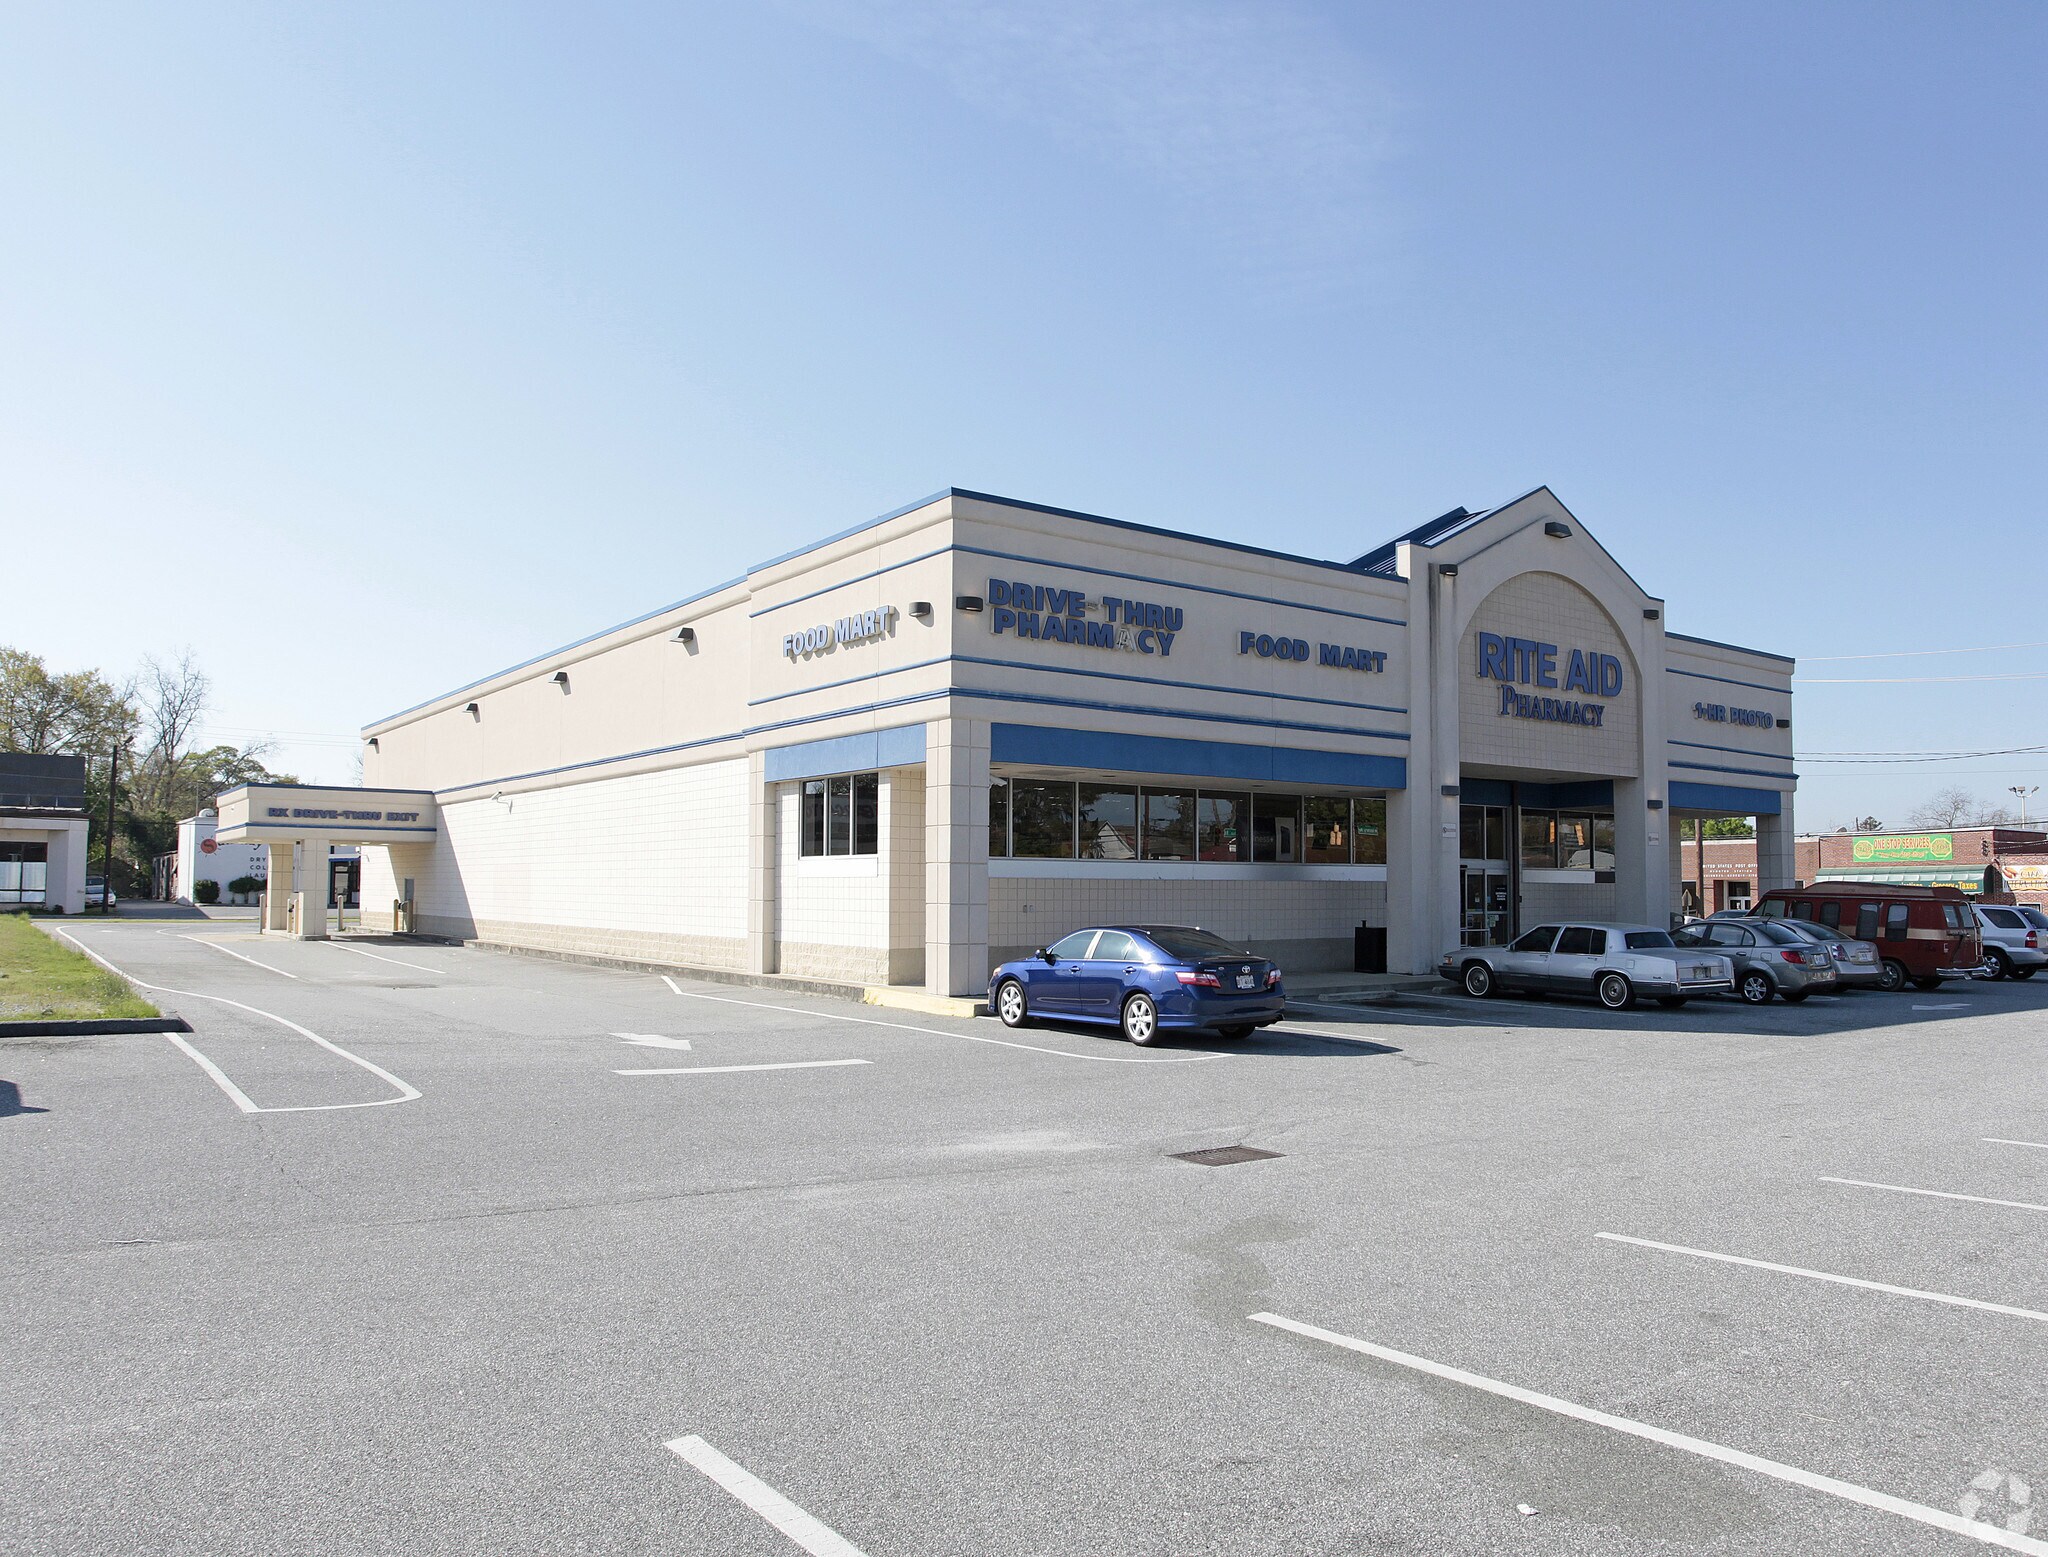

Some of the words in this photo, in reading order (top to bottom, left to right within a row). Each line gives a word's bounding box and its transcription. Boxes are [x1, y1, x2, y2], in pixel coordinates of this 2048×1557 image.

[987, 578, 1184, 632] DRIVE-THRU
[782, 624, 831, 657] FOOD
[835, 605, 892, 643] MART
[991, 608, 1176, 657] PHARMACY
[1239, 631, 1311, 662] FOOD
[1317, 643, 1388, 673] MART
[1477, 631, 1558, 688] RITE
[1563, 648, 1623, 697] AID
[1499, 684, 1606, 727] PHARMACY
[1694, 702, 1726, 722] 1-HR
[1729, 706, 1774, 729] PHOTO
[268, 807, 289, 818] RX
[293, 808, 382, 821] DRIVE-THRU
[386, 811, 419, 822] EXIT
[1873, 839, 1885, 849] ONE
[1887, 838, 1900, 849] STOP
[1902, 837, 1930, 849] SERVICES
[1958, 881, 1978, 890] Taxes
